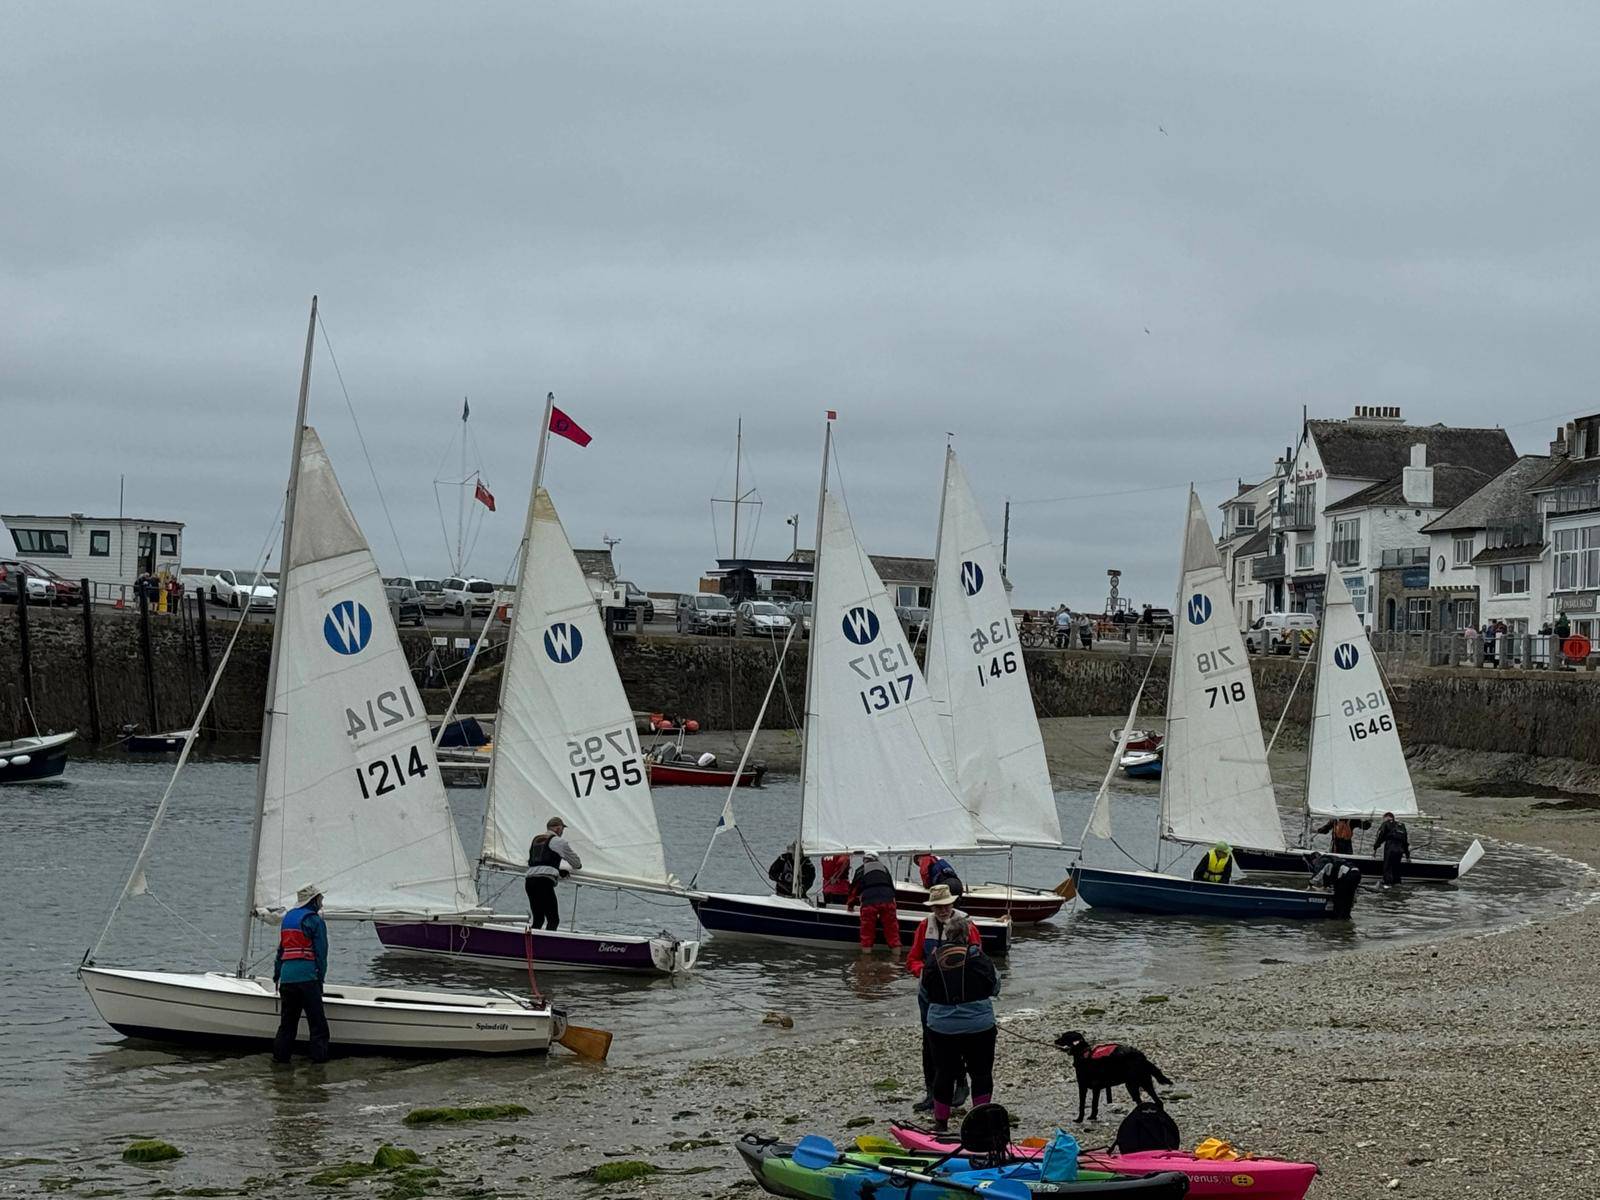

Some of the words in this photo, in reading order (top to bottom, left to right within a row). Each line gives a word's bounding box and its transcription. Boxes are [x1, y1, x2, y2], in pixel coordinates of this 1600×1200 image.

[328, 600, 363, 654] W
[846, 607, 873, 644] W
[1189, 593, 1208, 625] W
[546, 624, 574, 662] W
[1336, 643, 1355, 669] W
[860, 674, 914, 714] 1317
[1205, 681, 1246, 709] 718
[1349, 714, 1393, 741] 1646
[356, 745, 428, 799] 1214
[571, 759, 642, 798] 1795
[475, 1022, 509, 1031] Spindrift
